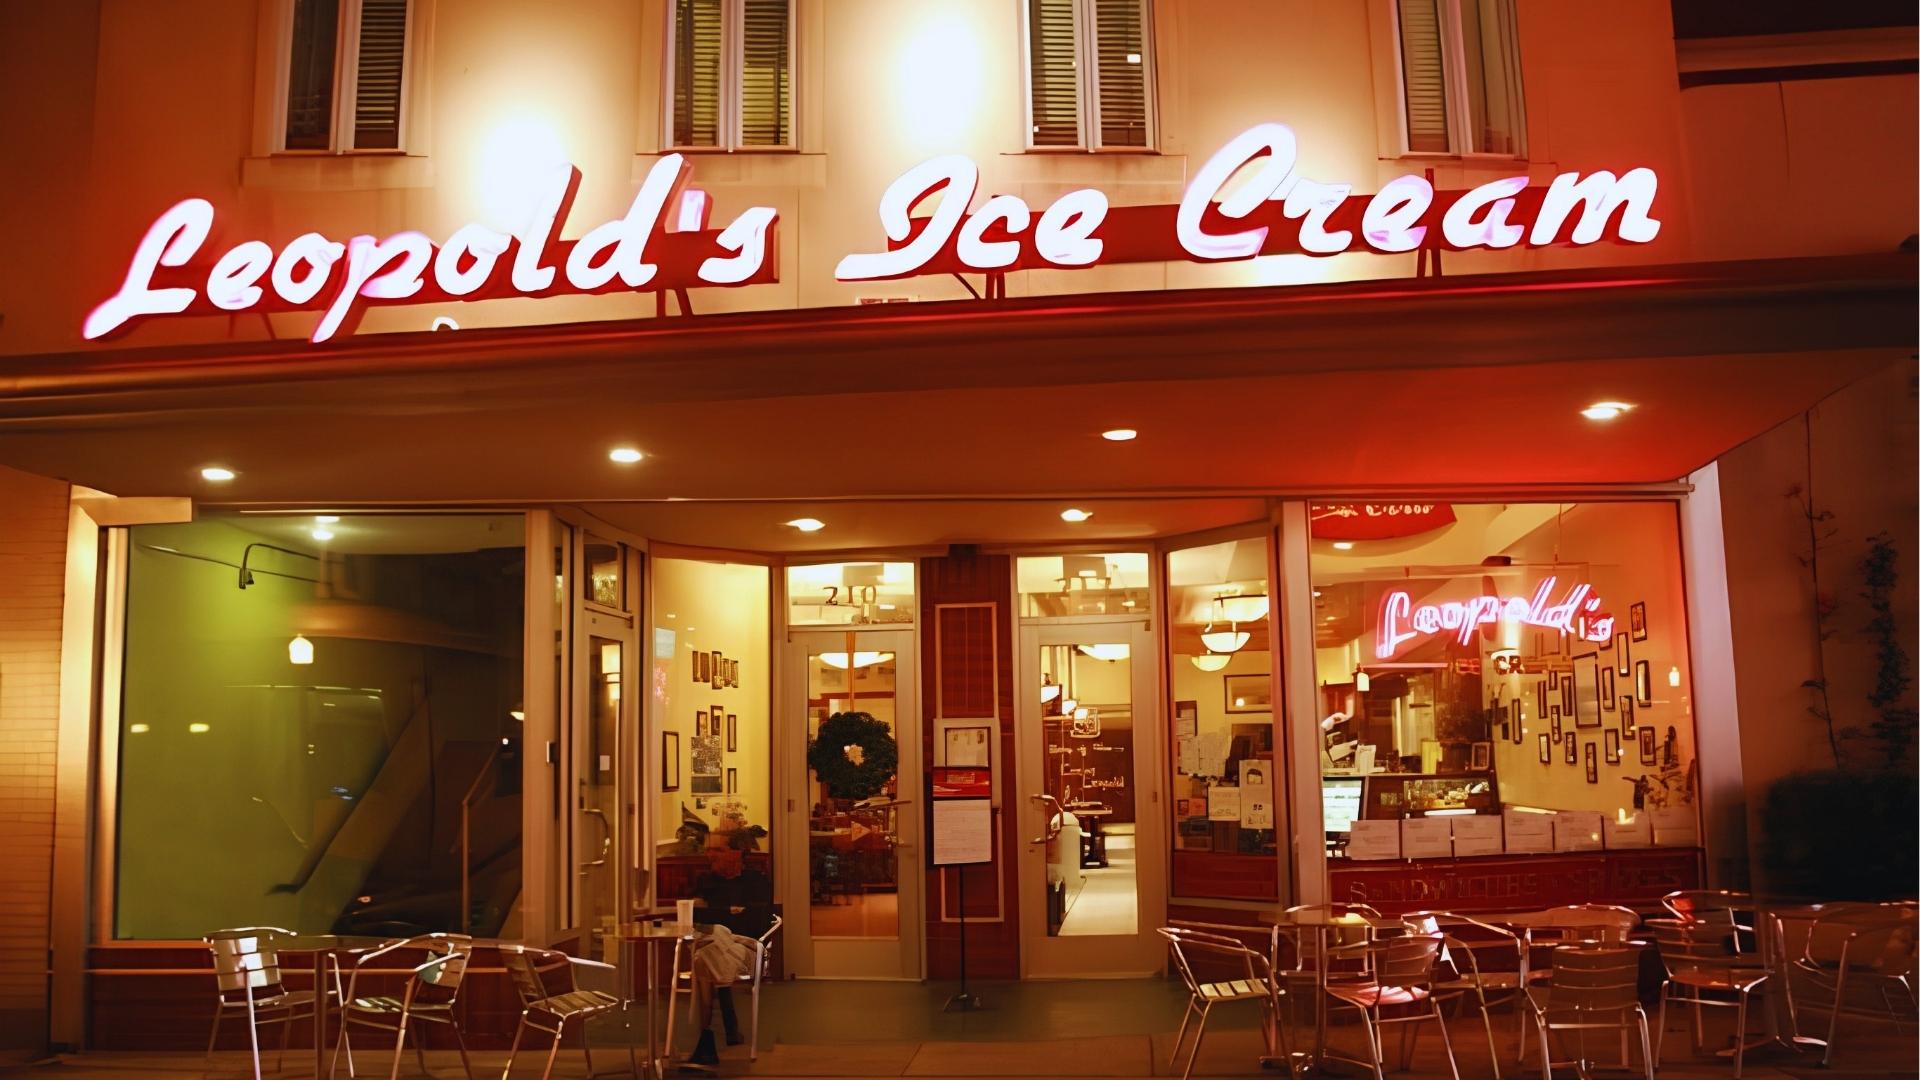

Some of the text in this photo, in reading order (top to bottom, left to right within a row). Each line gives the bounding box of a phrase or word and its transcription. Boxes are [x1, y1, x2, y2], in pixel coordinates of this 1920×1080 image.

[83, 122, 1662, 342] Leopold's Ice Cream
[823, 585, 878, 606] 210
[1377, 575, 1614, 659] Leopold's
